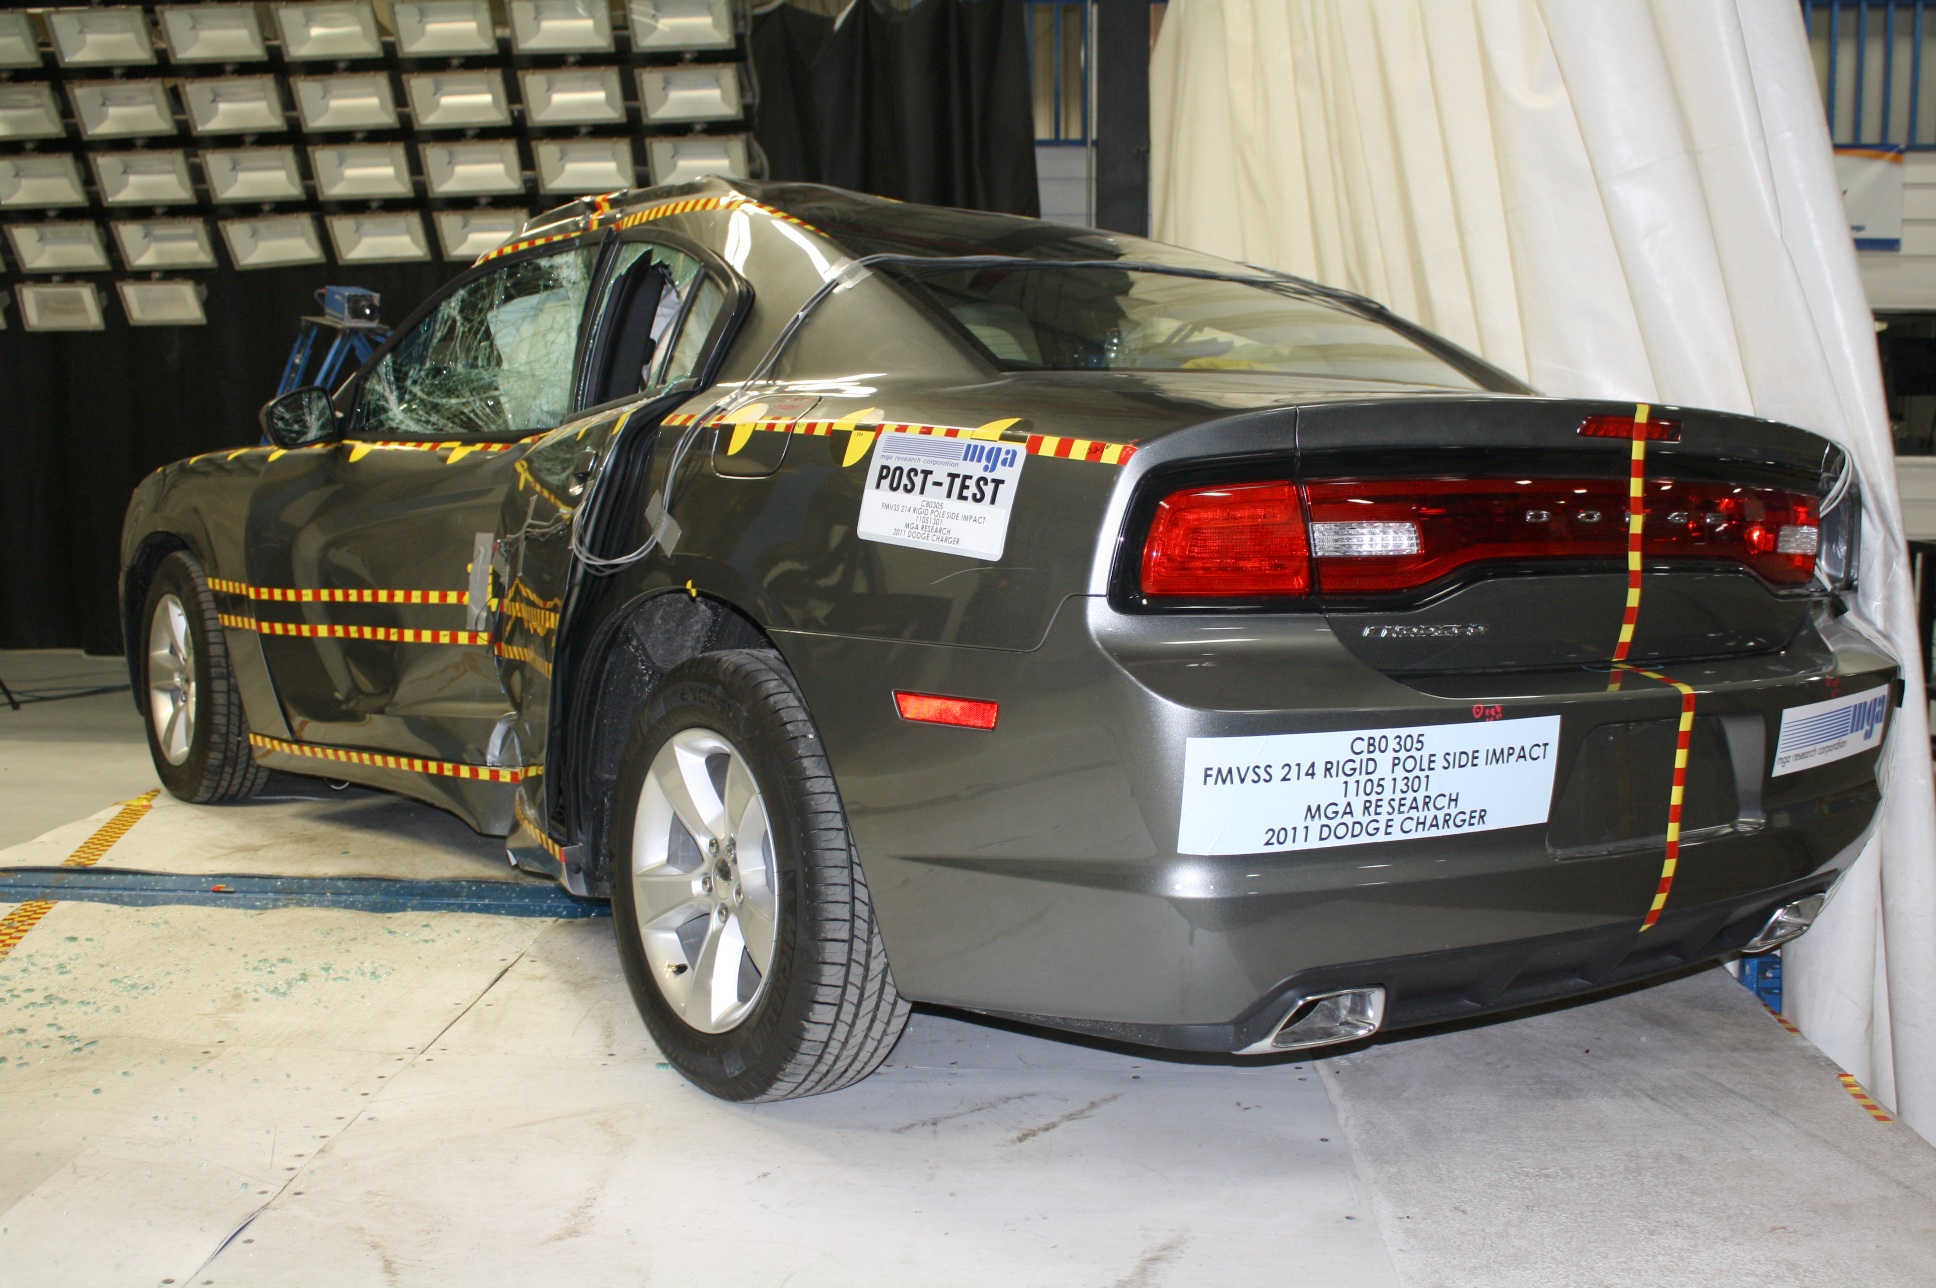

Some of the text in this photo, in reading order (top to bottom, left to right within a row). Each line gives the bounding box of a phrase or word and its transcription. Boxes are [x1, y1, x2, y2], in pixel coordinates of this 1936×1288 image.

[880, 454, 960, 468] mga research corporation
[962, 443, 1018, 473] mga
[875, 464, 1005, 505] POST-TEST
[881, 502, 987, 525] FMVSS 214 RIGID POLE SIDE IMPACT
[920, 500, 944, 510] CB0305
[904, 522, 951, 535] MGA RESEARCH
[915, 515, 943, 526] 11051301
[892, 528, 960, 545] 2011 DODGE CHARGER
[1849, 694, 1886, 741] mga
[1350, 733, 1425, 756] CB0305
[1792, 746, 1817, 762] research
[1817, 738, 1847, 759] corporation
[1203, 742, 1549, 786] FMVSS 214 RIGID POLE SIDE IMPACT
[1342, 774, 1430, 798] 11051301
[1304, 792, 1459, 822] MGA RESEARCH
[1264, 808, 1488, 847] 2011 DODGE CHARGER
